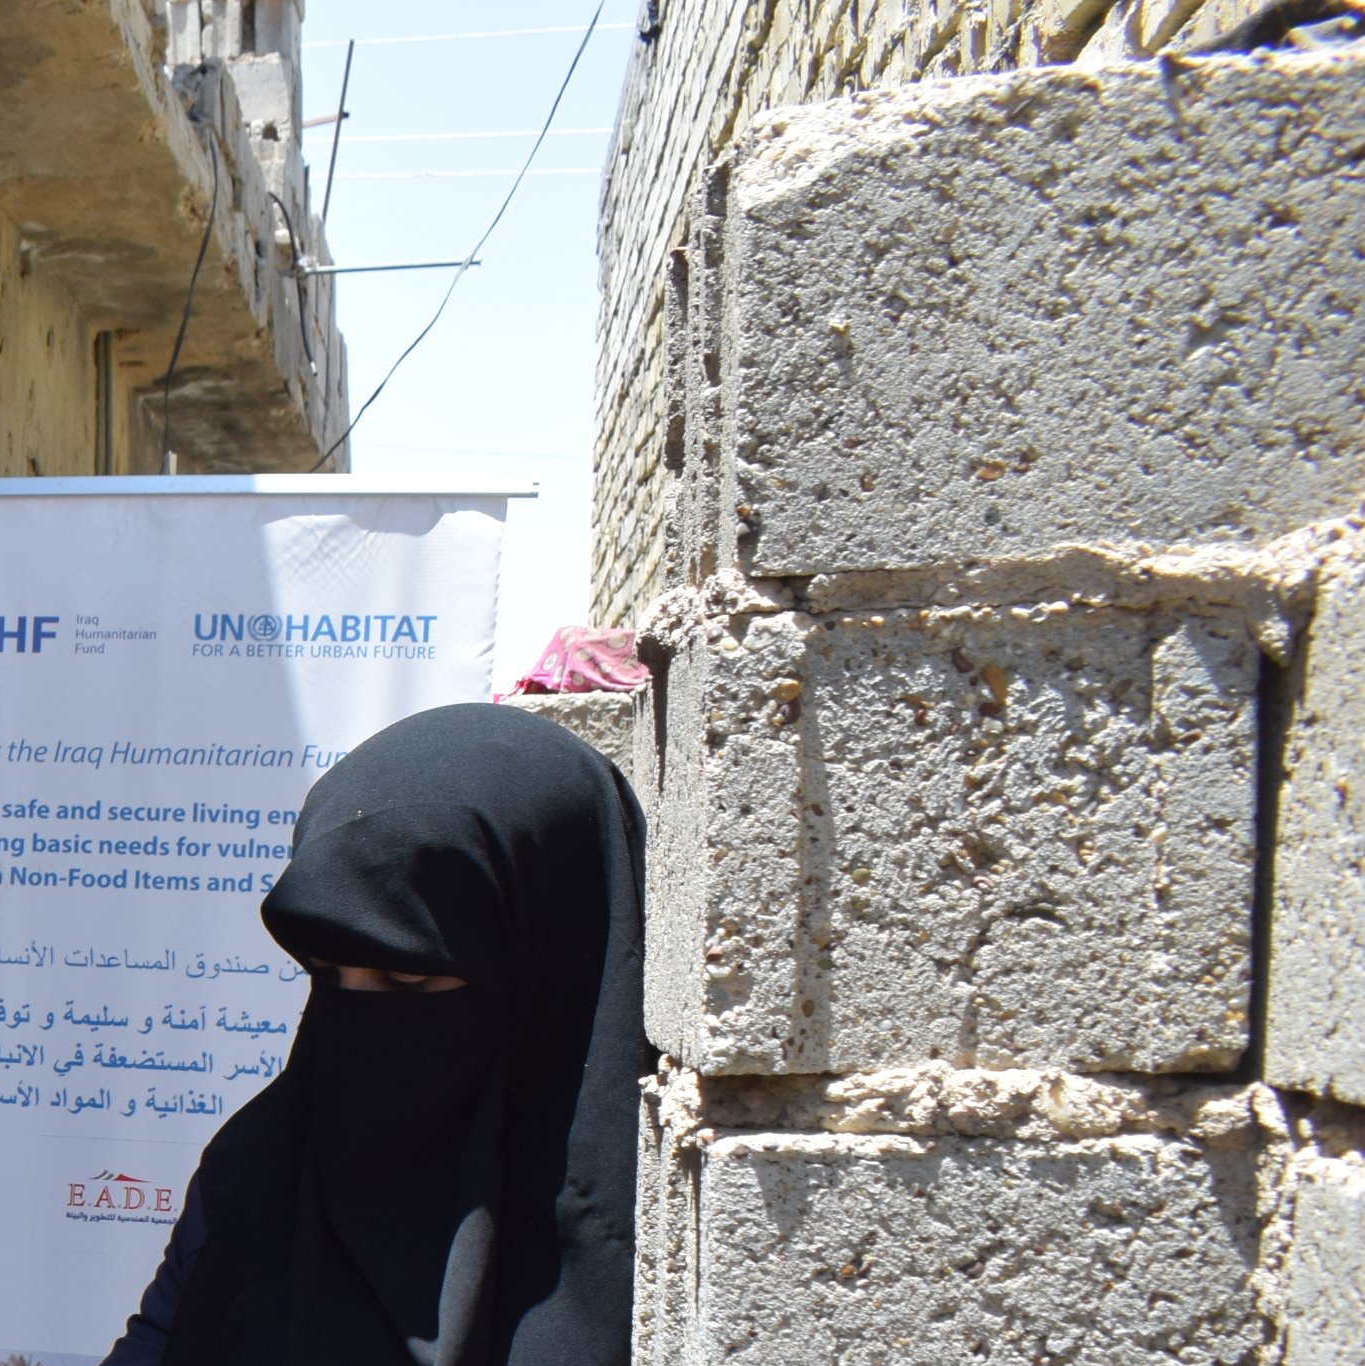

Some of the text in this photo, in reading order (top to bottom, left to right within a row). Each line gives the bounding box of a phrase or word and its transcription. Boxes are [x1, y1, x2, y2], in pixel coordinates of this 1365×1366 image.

[75, 614, 99, 626] Iraq
[74, 628, 157, 640] Humanitarian
[74, 643, 105, 655] Fund
[192, 643, 436, 660] FOR A BETTER URBAN FUTURE
[7, 739, 48, 763] the
[53, 740, 104, 769] Iraq
[110, 741, 294, 767] Humanitarian
[1, 799, 50, 819] safe
[56, 800, 101, 821] and
[107, 806, 186, 822] secure
[192, 803, 261, 829] living
[31, 832, 92, 854] basic
[98, 836, 170, 856] needs
[176, 836, 211, 857] for
[9, 866, 128, 889] Non-Food
[134, 870, 201, 891] Items
[206, 873, 253, 893] and
[64, 948, 176, 971] المساعدات
[185, 952, 269, 979] صندوق
[38, 1011, 55, 1031] و
[63, 1000, 128, 1032] سليمة
[137, 1016, 153, 1034] و
[216, 1007, 287, 1039] معيشة
[53, 1042, 85, 1076] في
[92, 1042, 213, 1074] المستضعفة
[50, 1089, 111, 1114] المواد
[120, 1098, 137, 1117] و
[145, 1087, 223, 1118] الغذائية
